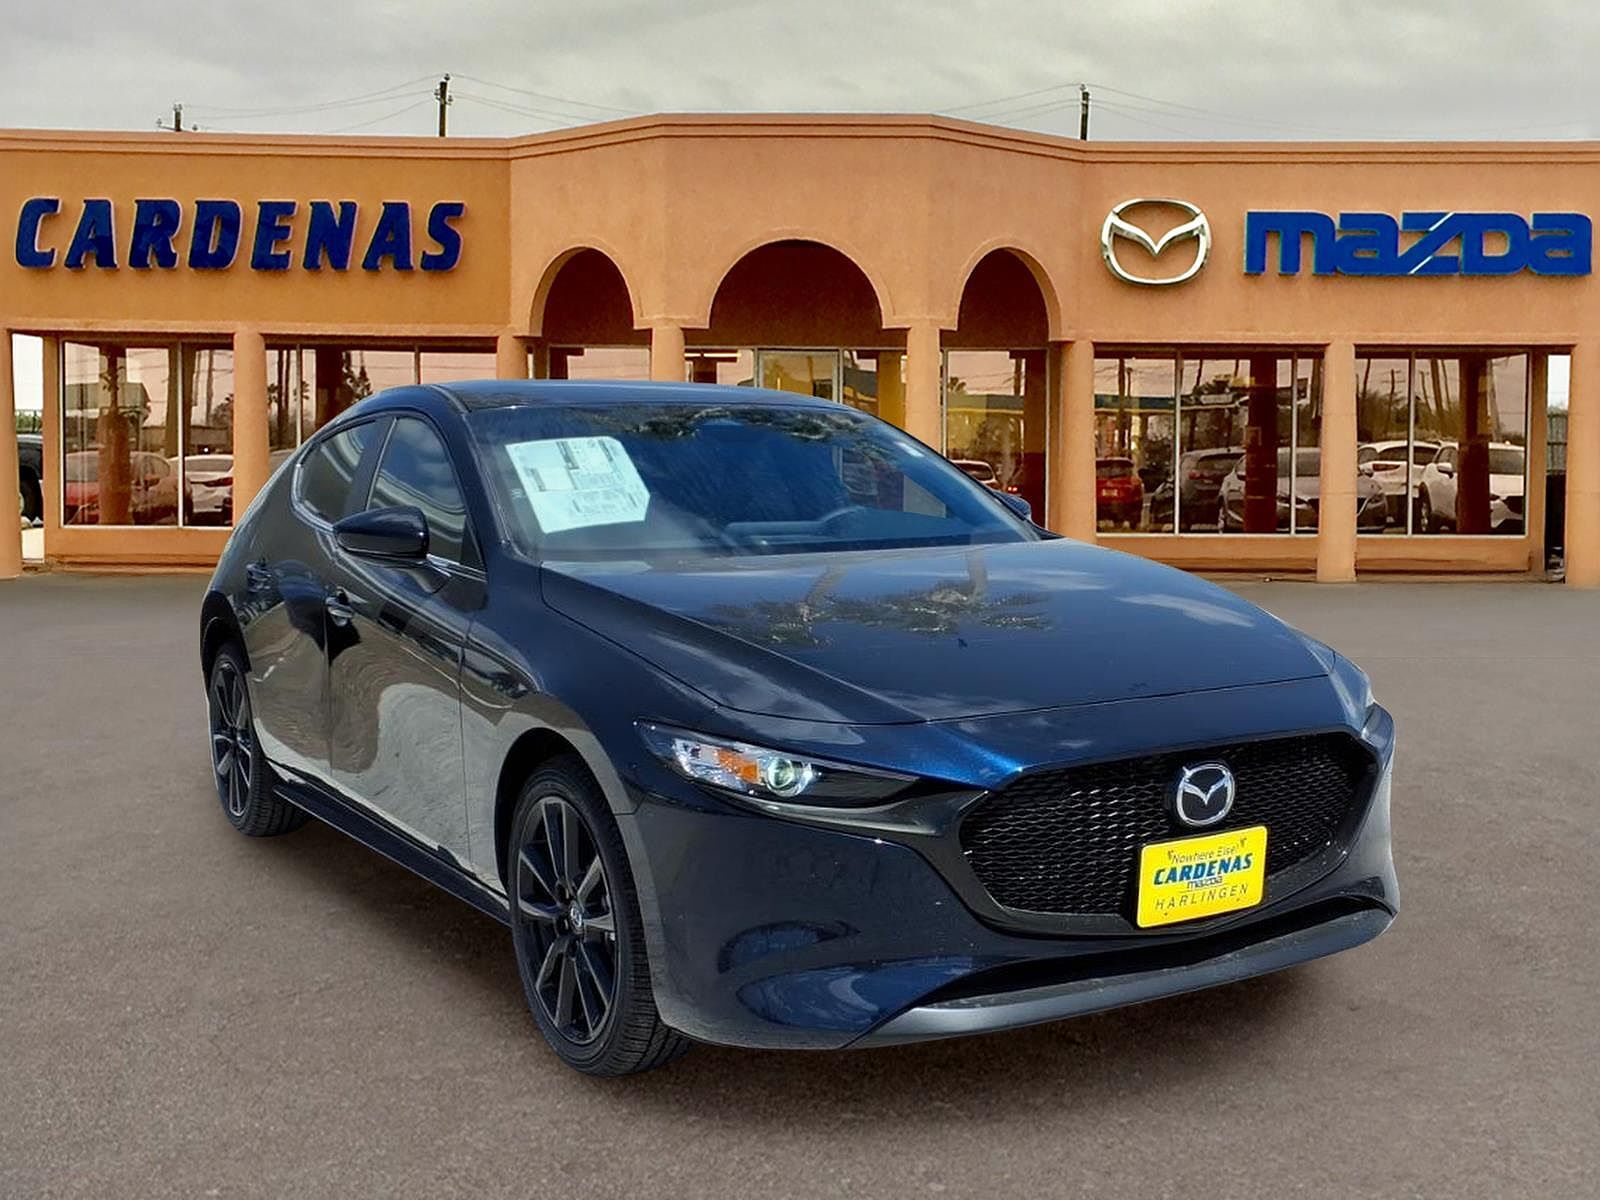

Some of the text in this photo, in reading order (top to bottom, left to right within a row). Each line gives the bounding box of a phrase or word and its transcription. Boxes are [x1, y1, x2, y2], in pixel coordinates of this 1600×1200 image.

[15, 197, 465, 271] CARDENAS
[1154, 853, 1253, 885] CARDENAS
[1155, 884, 1248, 910] HARLINGEN
